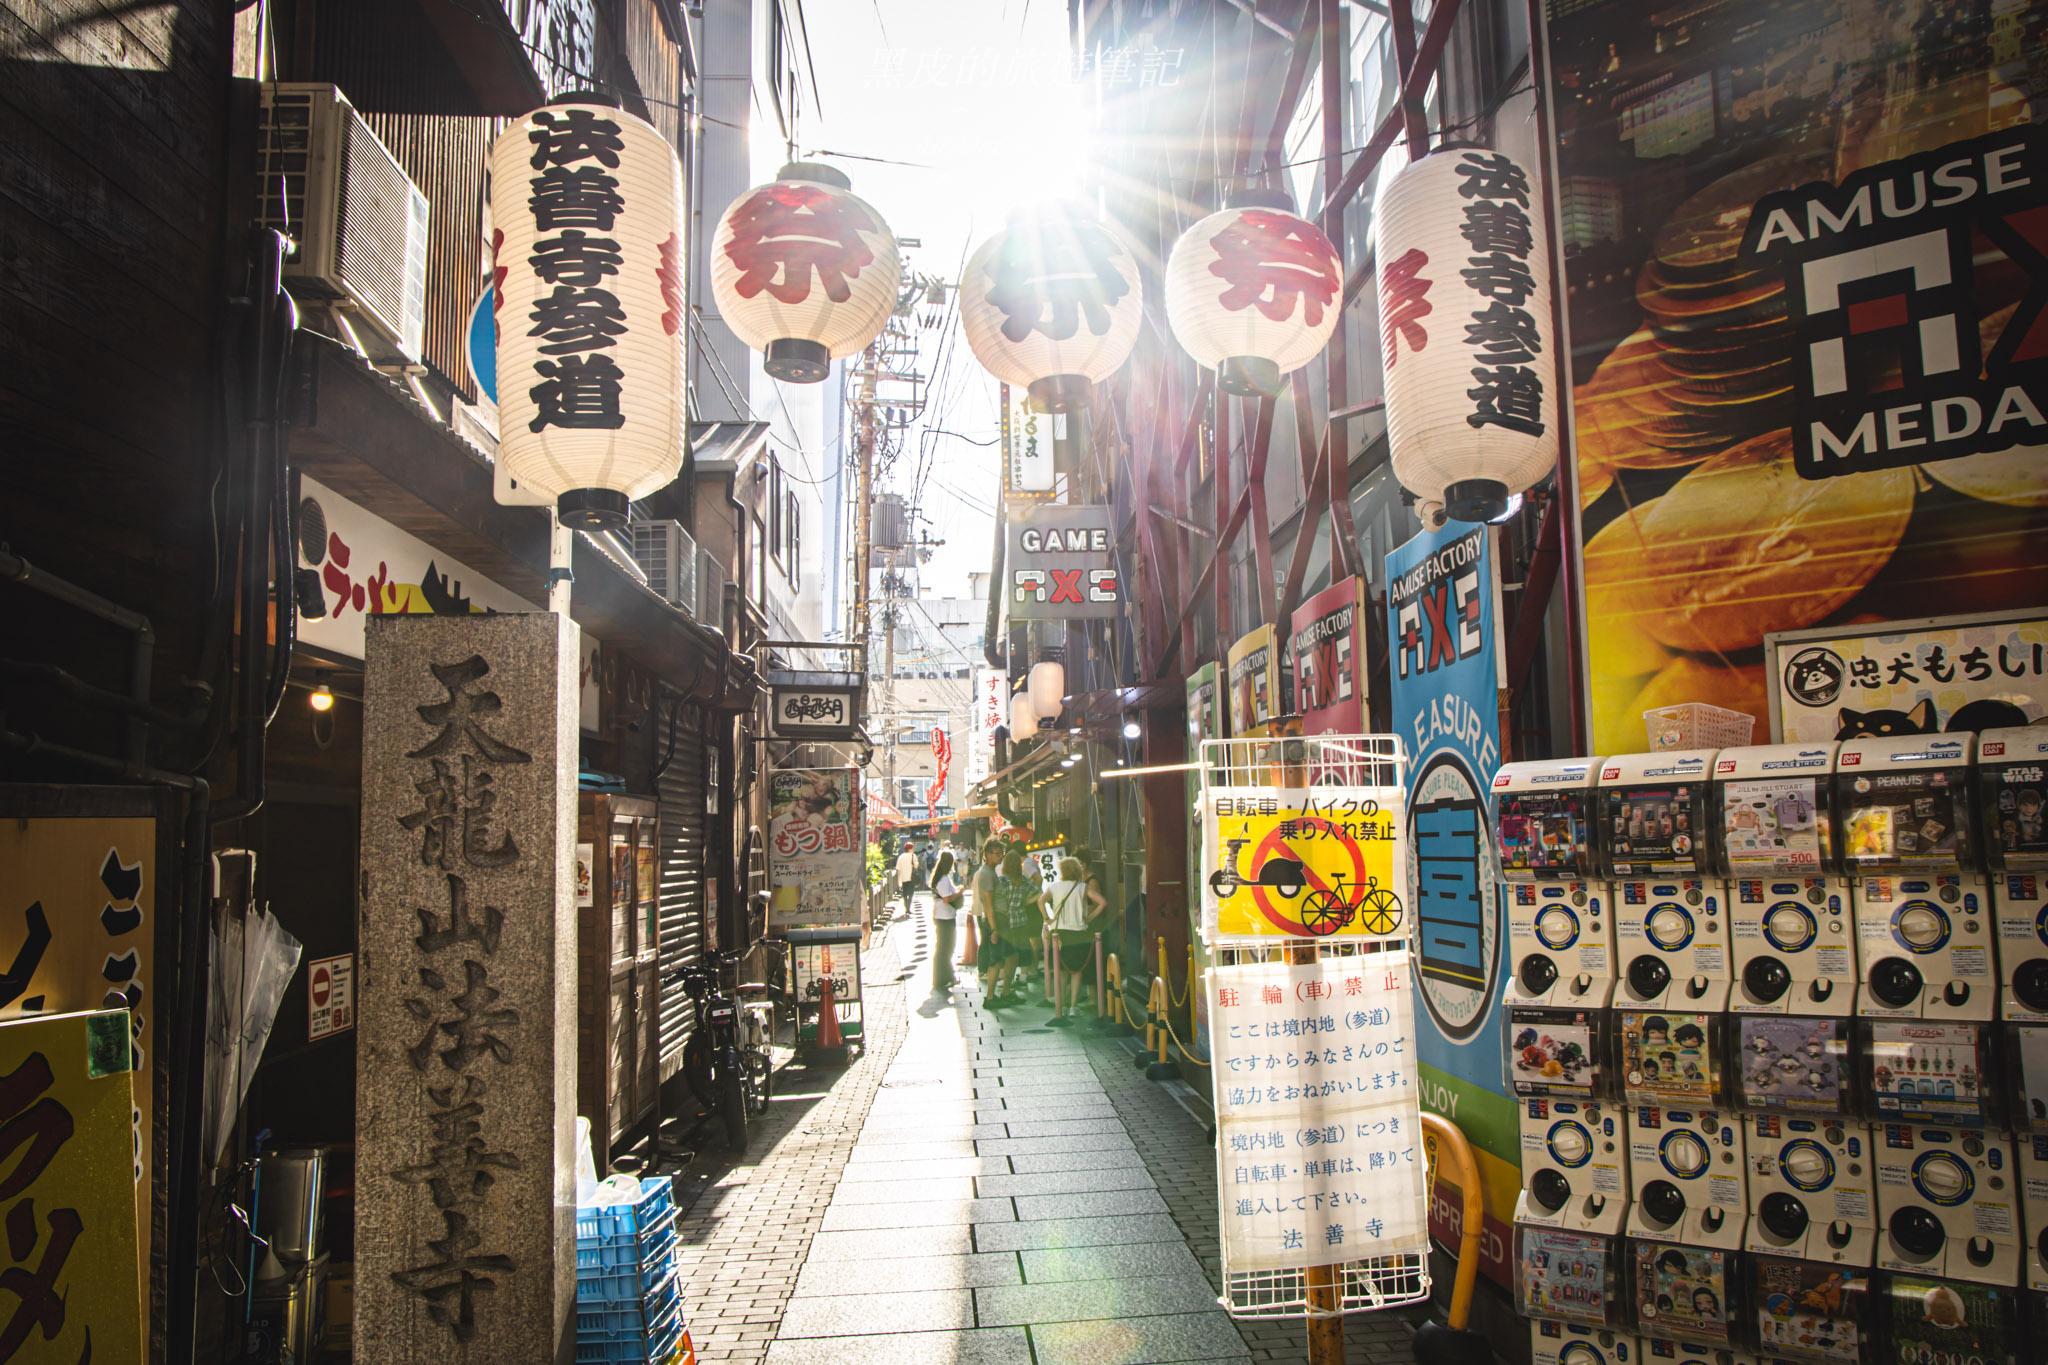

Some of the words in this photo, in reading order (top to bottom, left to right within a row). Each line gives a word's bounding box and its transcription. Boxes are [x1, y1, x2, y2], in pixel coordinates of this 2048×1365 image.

[1755, 143, 2031, 253] AMUSE
[724, 185, 875, 304] 祭
[527, 108, 627, 433] 法善寺参道
[1208, 209, 1340, 327] 祭
[1455, 153, 1545, 437] 法善寺参道
[1021, 397, 1039, 458] るま
[1810, 385, 2048, 463] MEDA
[1022, 529, 1108, 552] GAME
[1392, 565, 1425, 604] AMUSE
[1426, 531, 1483, 583] FACTORY
[1014, 569, 1117, 603] AXE
[1296, 626, 1315, 651] AMUSE
[1315, 606, 1353, 640] FACTORY
[1399, 570, 1481, 675] AXE
[1241, 648, 1268, 672] FACTORY
[1299, 635, 1352, 712] AXE
[1403, 693, 1497, 786] LEASURE
[1877, 775, 1922, 787] PEANUTS
[2003, 774, 2041, 783] WARS
[2007, 767, 2043, 777] STAR
[1215, 797, 1379, 817] 自転車・バイクの
[774, 824, 849, 855] もつ鍋
[1280, 821, 1397, 841] 乗り入れ禁止
[1791, 853, 1811, 863] 500
[391, 653, 532, 1339] 天龍山法善寺
[1230, 1007, 1391, 1039] ここは境内地（参道）
[1226, 1037, 1405, 1071] ですからみなさんのご
[1229, 1071, 1408, 1106] 協力をおねがいします。
[1419, 1077, 1459, 1118] NJOY
[1230, 1117, 1400, 1152] 境内地（参道）につき
[1235, 1148, 1414, 1184] 自転車・単車は、降りて
[1236, 1192, 1368, 1216] 進入して下さい。
[1429, 1193, 1504, 1264] RPRED
